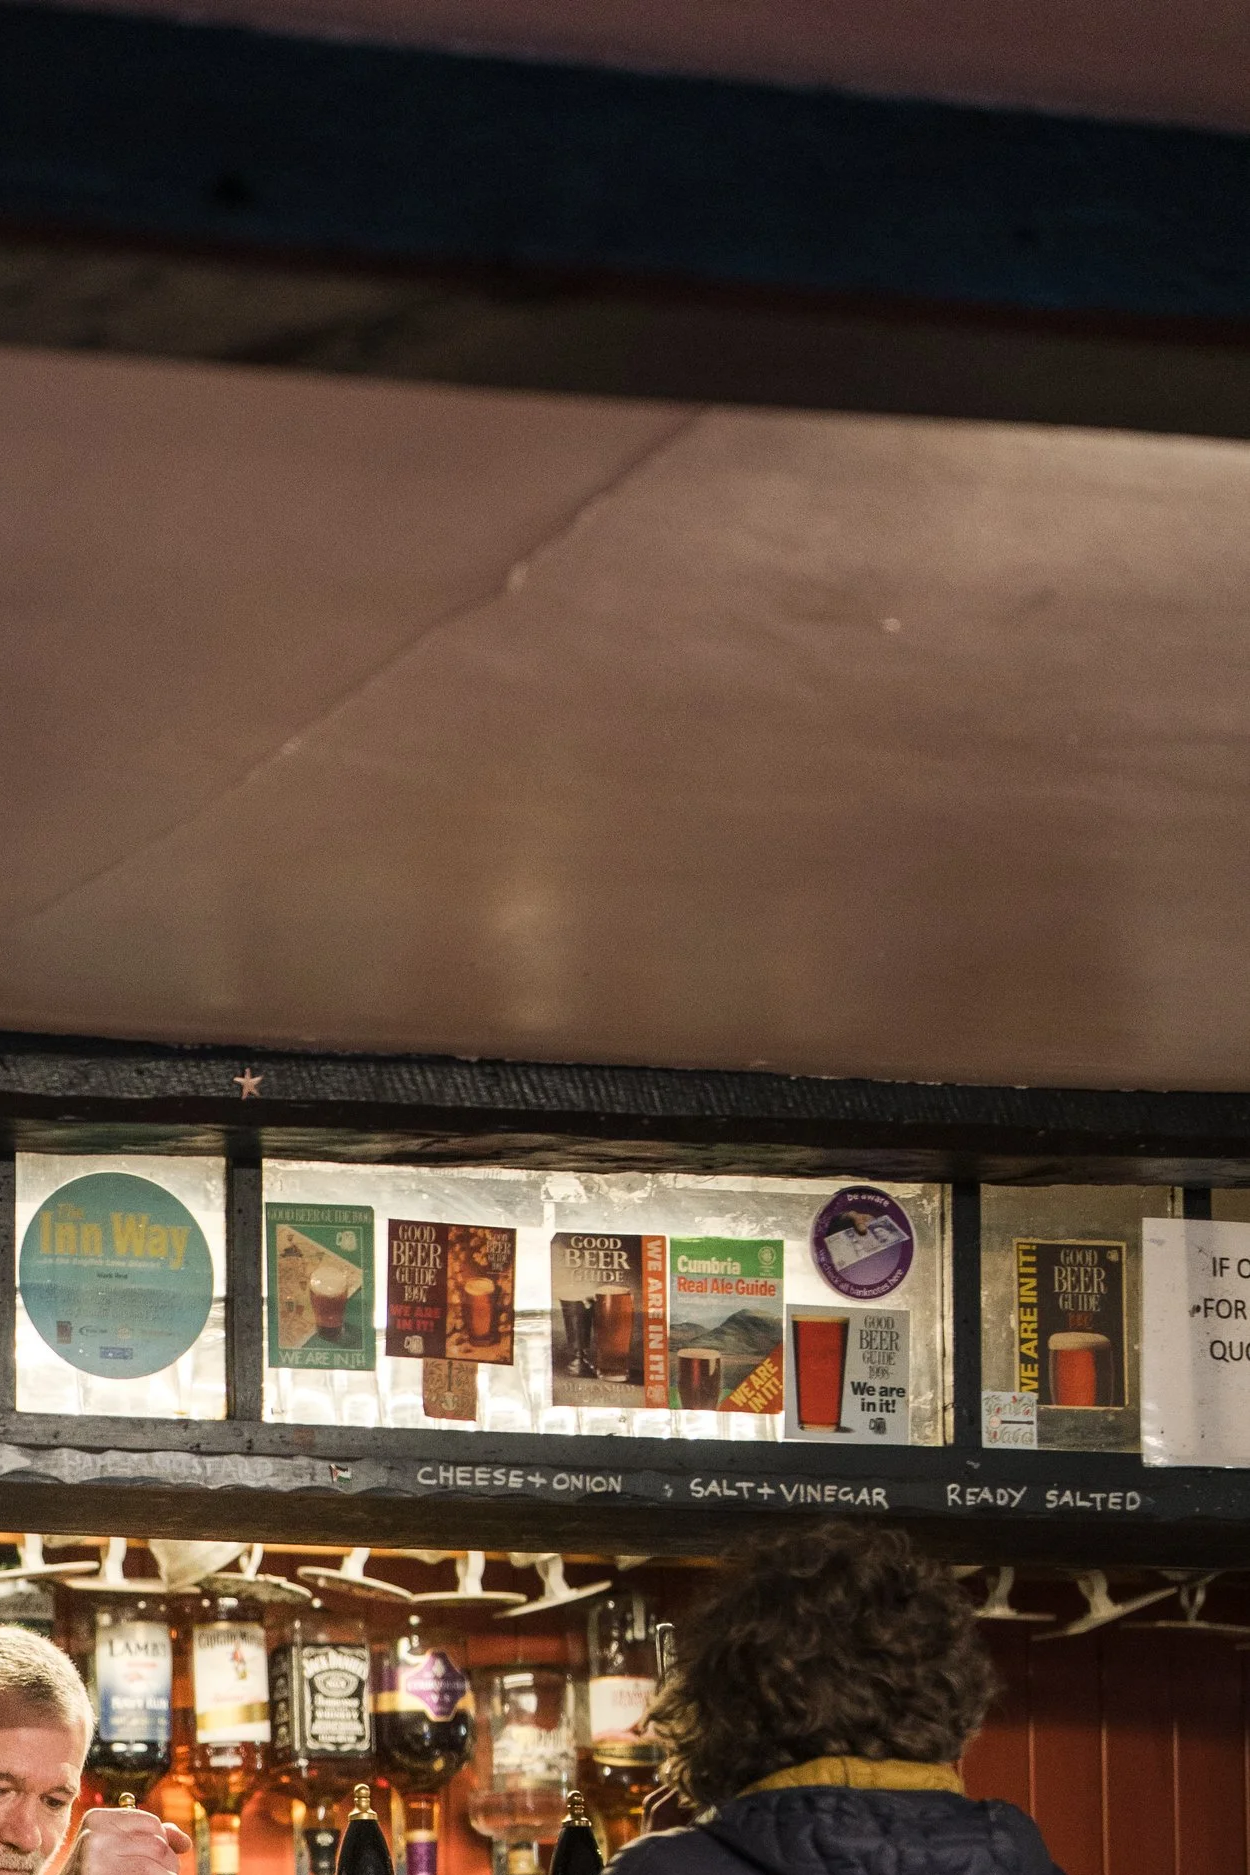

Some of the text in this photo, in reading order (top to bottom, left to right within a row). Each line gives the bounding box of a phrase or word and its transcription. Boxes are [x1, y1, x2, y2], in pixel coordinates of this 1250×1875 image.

[846, 1193, 859, 1202] be
[40, 1210, 191, 1270] Inn Way
[398, 1224, 436, 1241] GOOD
[570, 1235, 622, 1250] GOOD
[392, 1241, 442, 1268] BEER
[564, 1249, 630, 1270] BEER
[676, 1254, 742, 1275] Cumbria
[1060, 1249, 1099, 1266] GOOD
[395, 1267, 437, 1286] GUIDE
[570, 1269, 624, 1283] GUIDE
[1212, 1256, 1230, 1278] IF
[677, 1276, 777, 1297] Real Ale Guide
[1053, 1266, 1108, 1294] BEER
[647, 1239, 666, 1382] WE ARE IN IT!
[1058, 1294, 1101, 1312] GUIDE
[1203, 1298, 1247, 1320] FOR
[864, 1315, 895, 1330] GOOD
[1018, 1243, 1038, 1393] WE ARE IN IT!
[859, 1330, 900, 1351] BEER
[279, 1352, 301, 1364] WE
[305, 1353, 329, 1365] ARE
[333, 1353, 350, 1366] IN
[862, 1350, 896, 1366] GUIDE
[729, 1357, 779, 1407] WE ARE
[851, 1381, 906, 1398] We are
[747, 1376, 784, 1413] IN IT!
[860, 1398, 896, 1413] in it!
[947, 1483, 1142, 1512] READY SALTED
